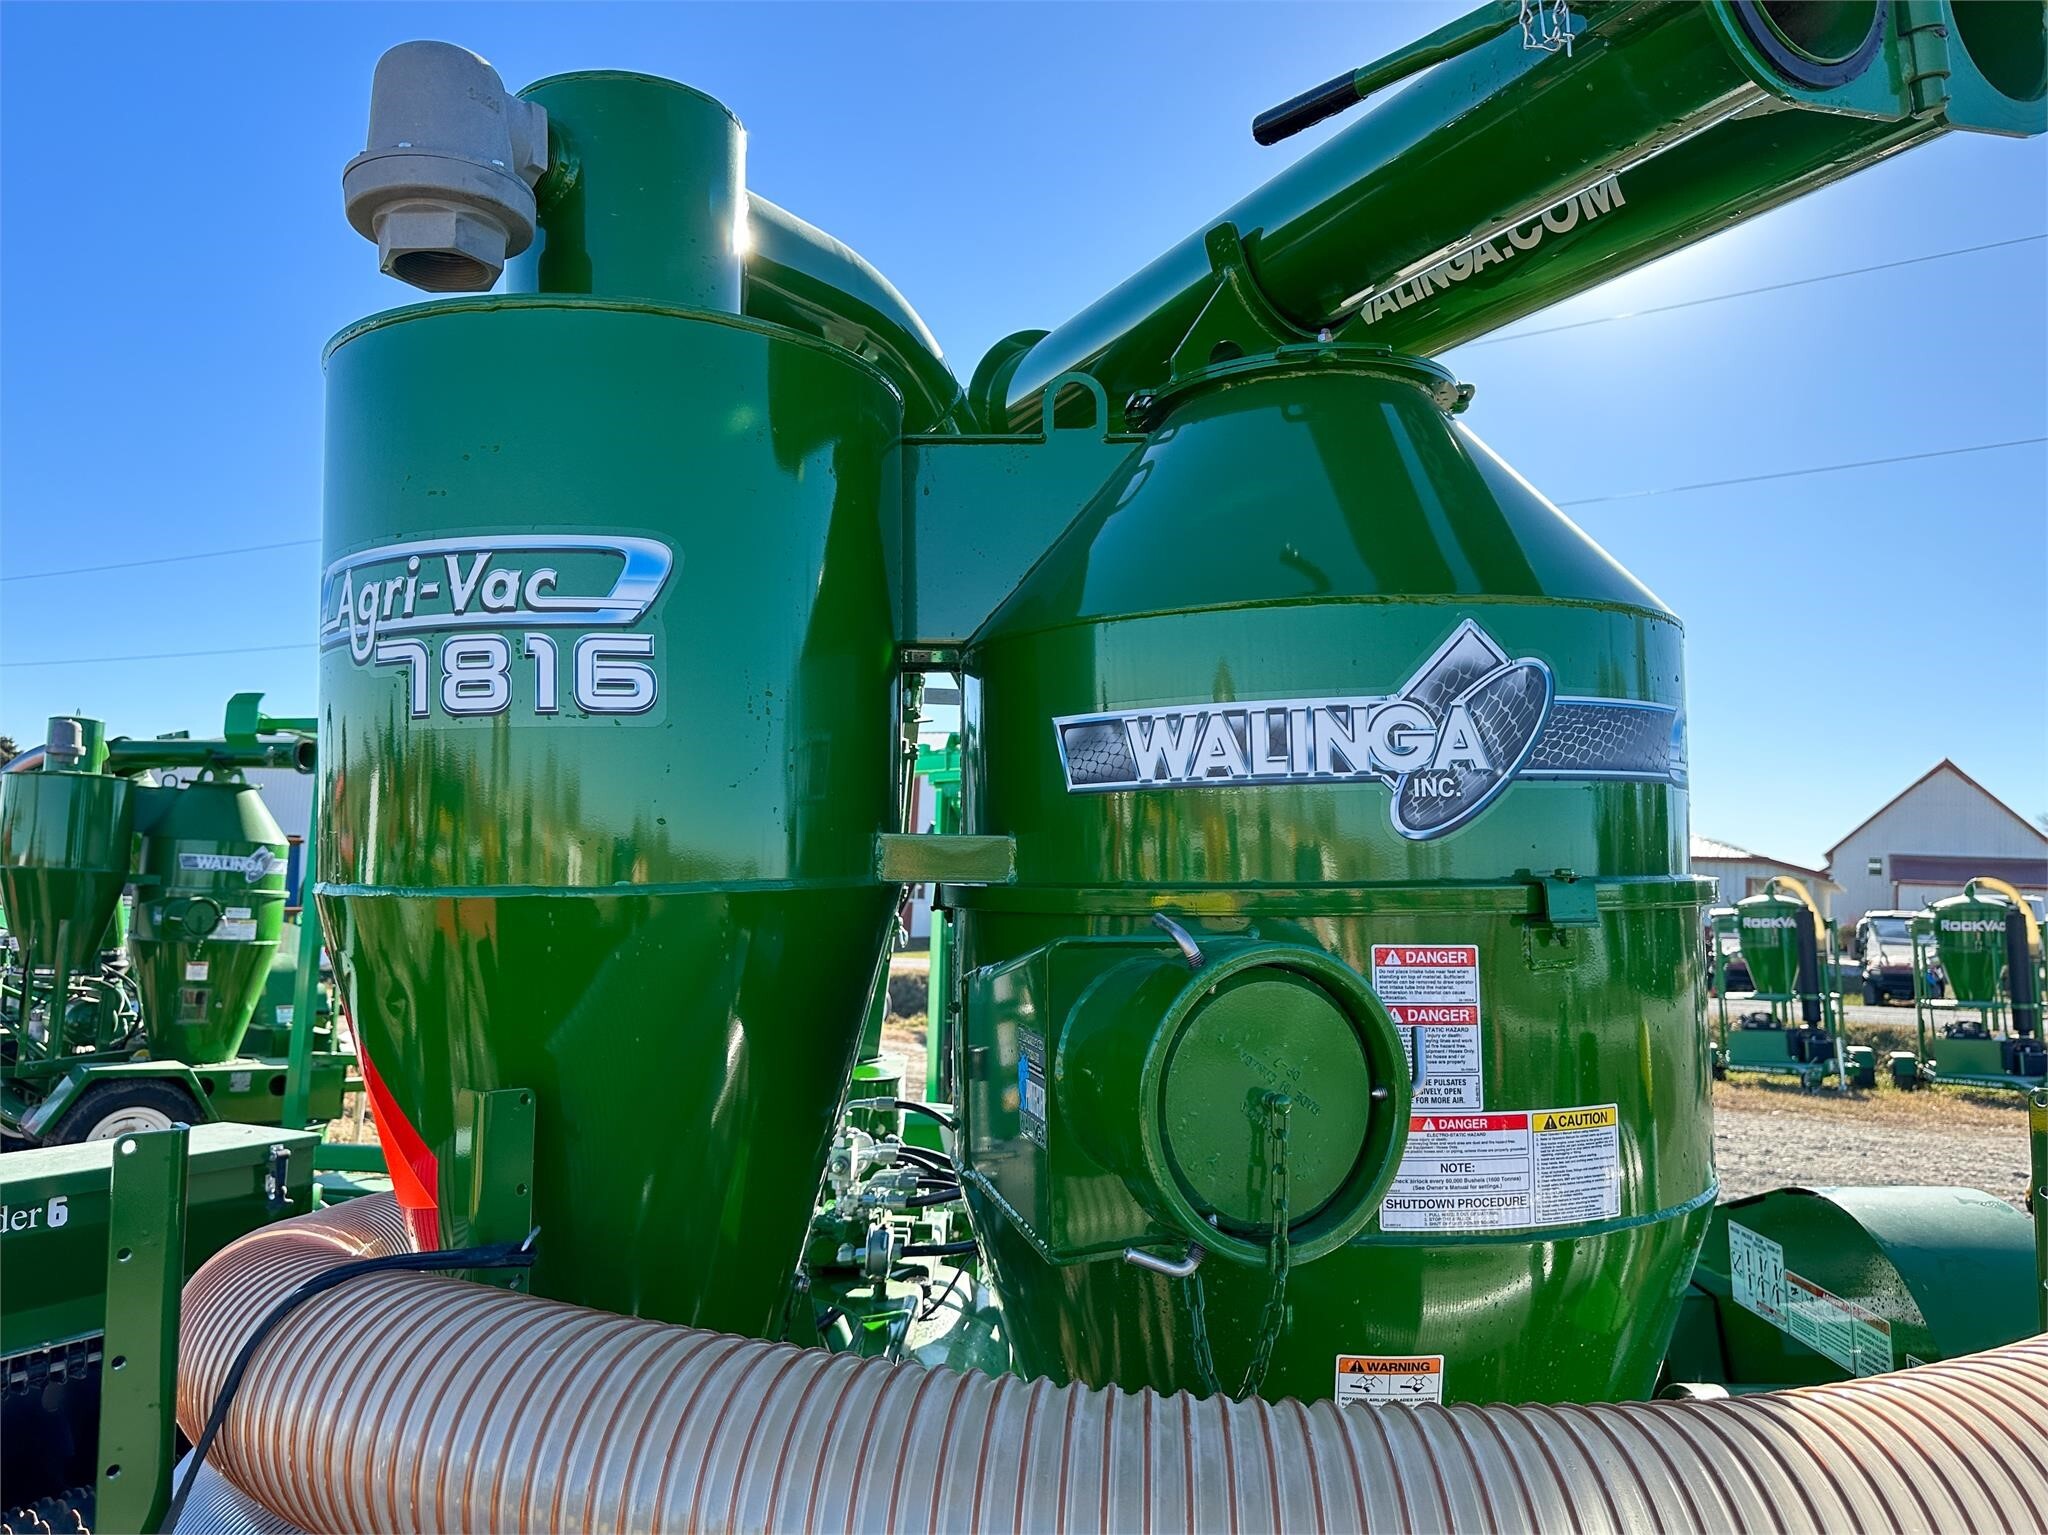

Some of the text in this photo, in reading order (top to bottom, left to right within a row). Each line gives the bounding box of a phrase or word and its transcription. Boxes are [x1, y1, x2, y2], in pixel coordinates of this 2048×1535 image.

[336, 551, 558, 665] Agri-Vac
[375, 632, 658, 718] 7816
[1124, 700, 1494, 782] WALINGA
[1413, 777, 1462, 799] INC.
[197, 856, 264, 872] WALINGA
[1743, 916, 1797, 928] ROCKVA
[1406, 952, 1468, 963] DANGER
[1407, 1010, 1469, 1022] DANGER
[1439, 1119, 1488, 1130] DANGER
[1558, 1112, 1608, 1127] CAUTION
[1440, 1163, 1475, 1173] NOTE:
[1386, 1196, 1527, 1209] SHUTDOWN PROCEDURE
[47, 1195, 68, 1228] 6
[1366, 1362, 1430, 1372] WARNING
